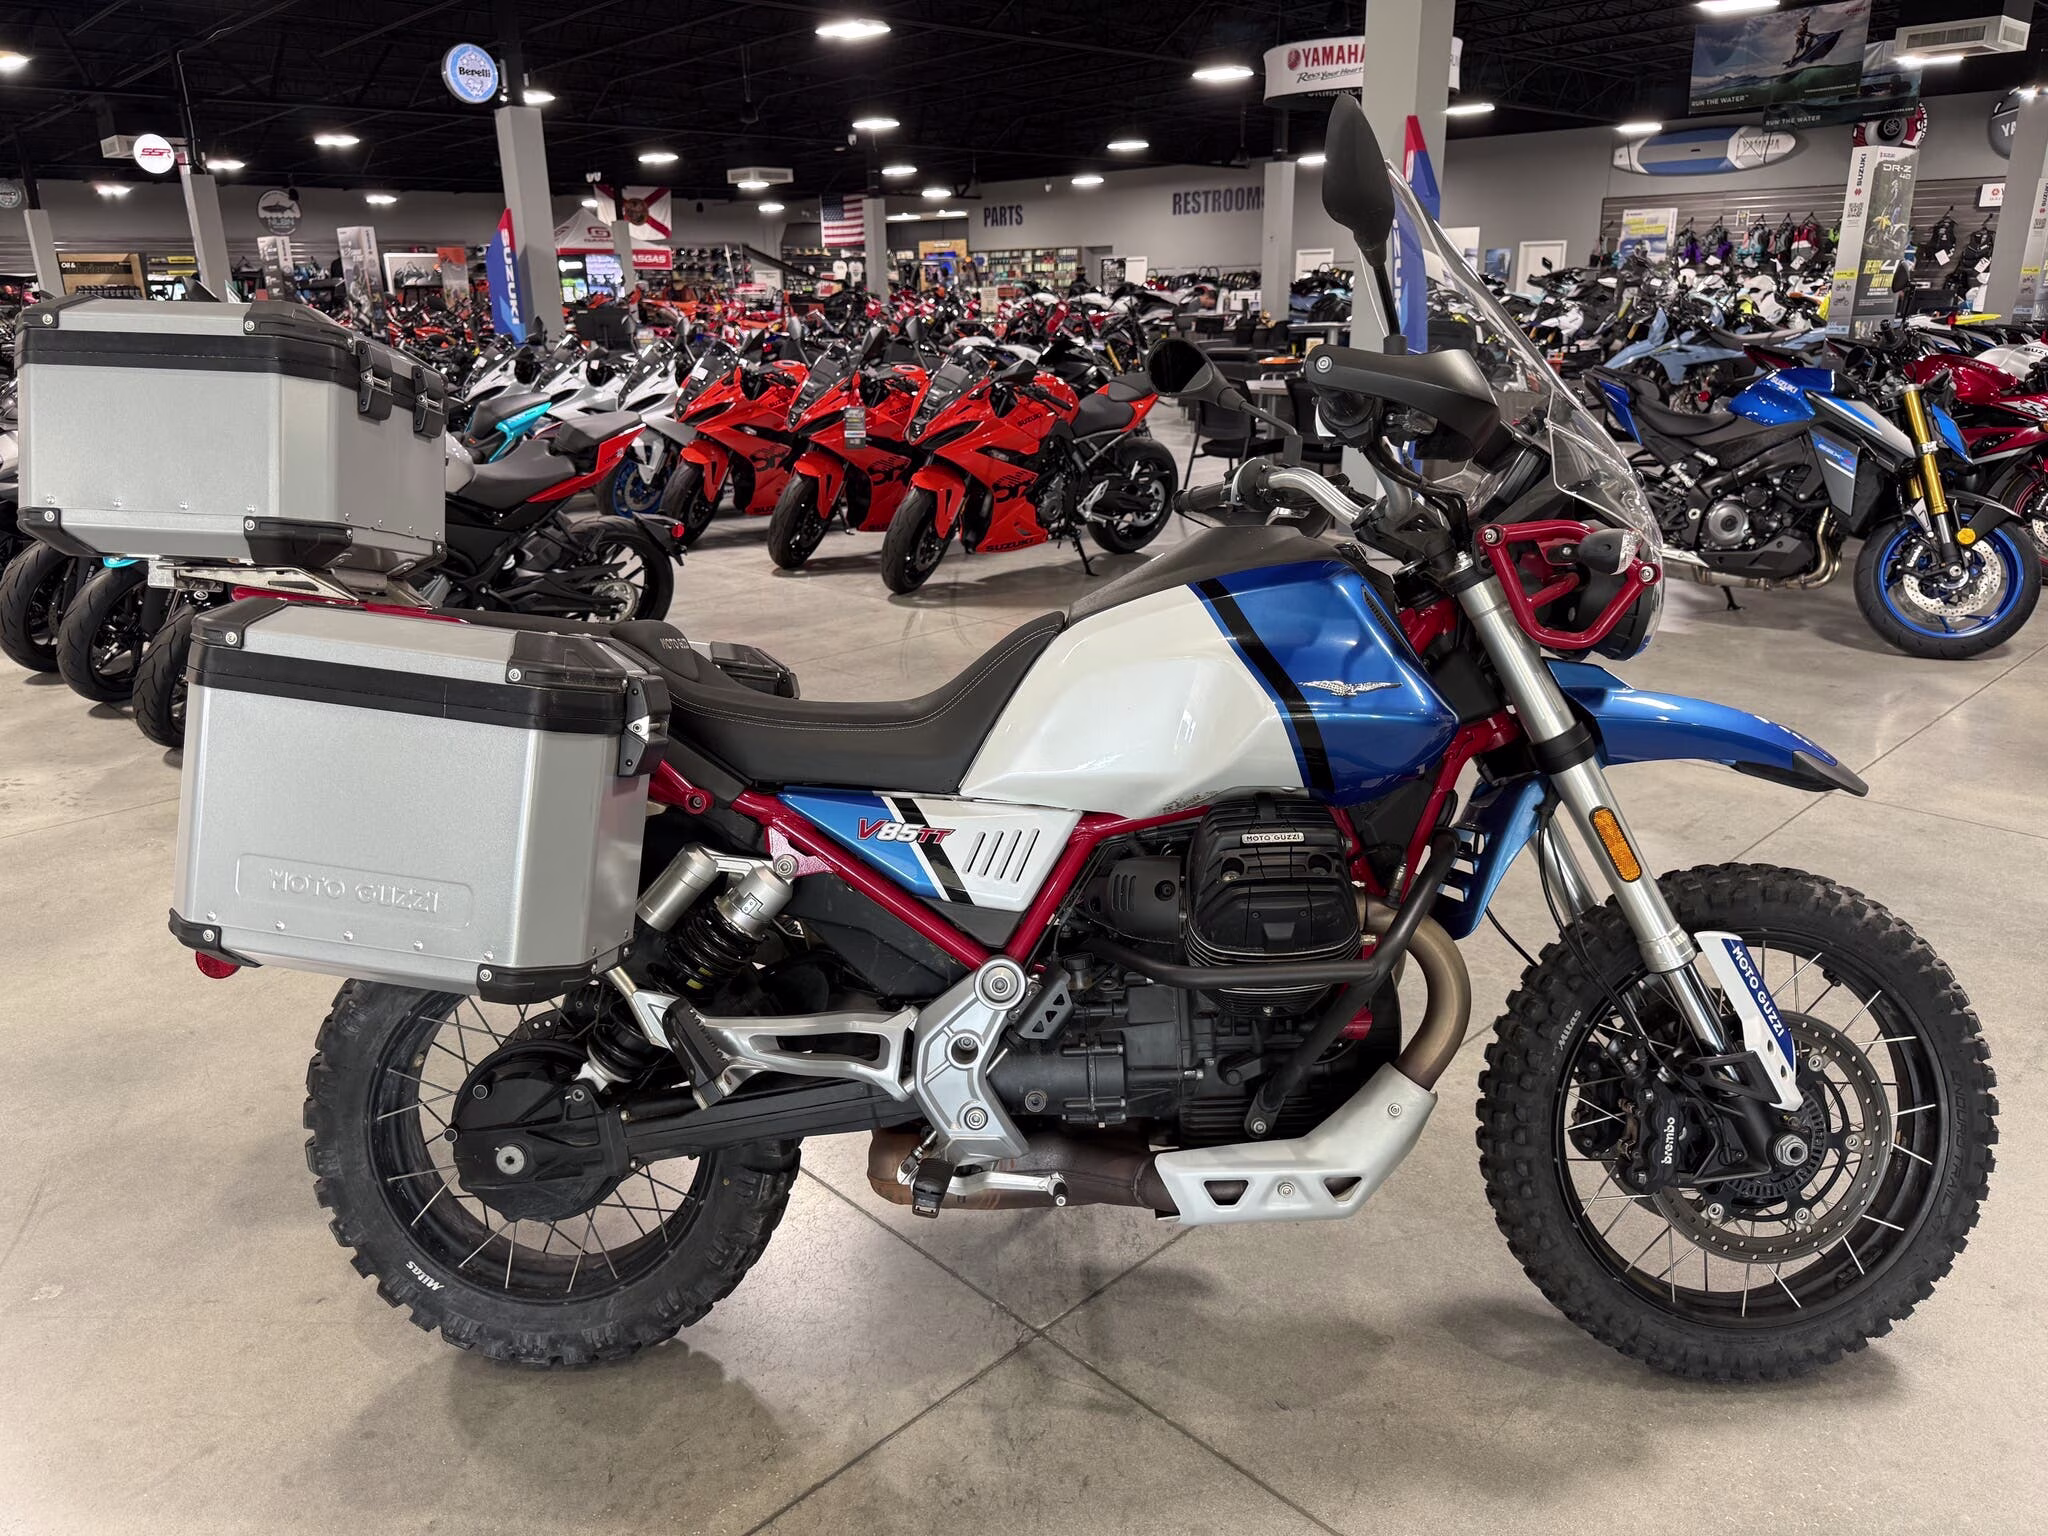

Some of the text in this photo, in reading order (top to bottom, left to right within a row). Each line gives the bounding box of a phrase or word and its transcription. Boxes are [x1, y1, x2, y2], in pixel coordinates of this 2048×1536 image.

[1857, 153, 1867, 187] SUZUKI
[984, 205, 1023, 227] PARTS
[501, 228, 520, 325] SUZUKI
[632, 255, 667, 264] ASGAS
[1246, 833, 1301, 842] MOTO GUZZI
[269, 869, 439, 914] MOTO GUZZI
[1732, 946, 1785, 1037] MOTO GUZZI
[1660, 1117, 1676, 1165] brembo
